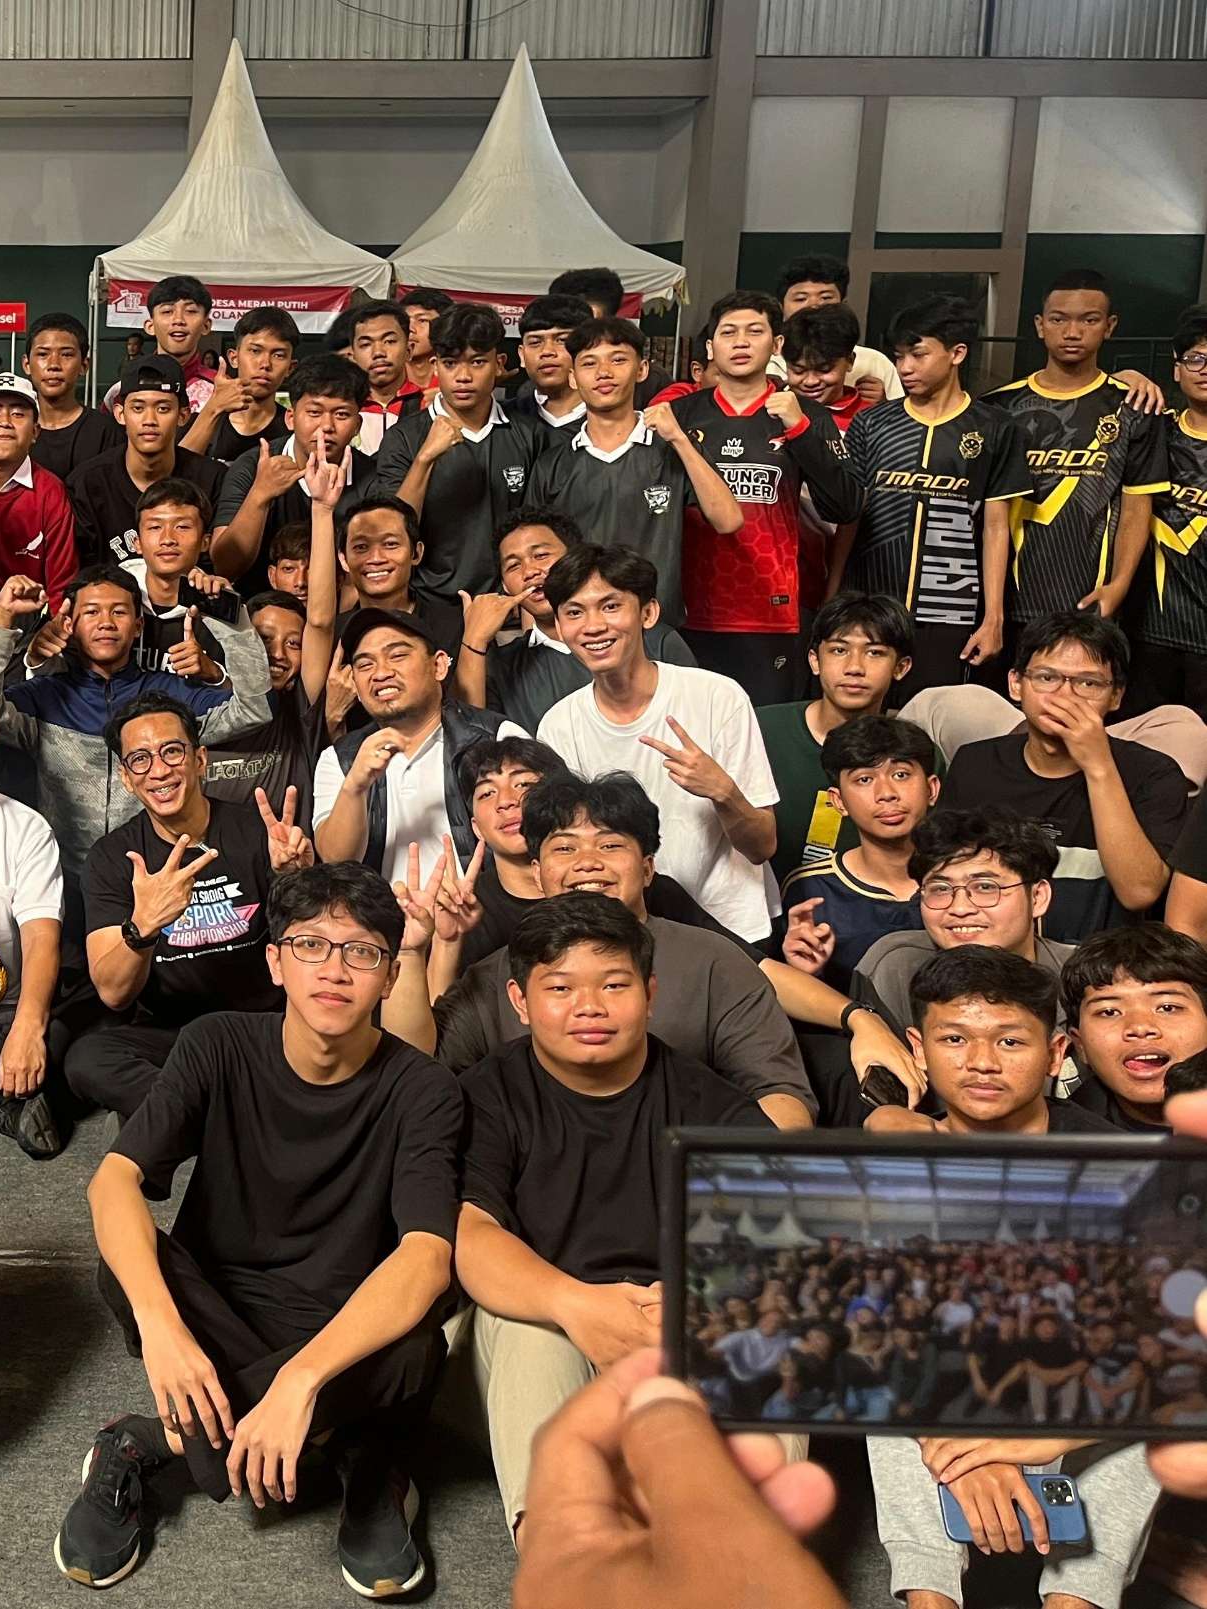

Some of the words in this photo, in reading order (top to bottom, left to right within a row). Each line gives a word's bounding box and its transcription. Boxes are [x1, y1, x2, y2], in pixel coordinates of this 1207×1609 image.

[238, 300, 275, 308] MERAH
[277, 301, 308, 309] PUTIH
[168, 920, 250, 946] CHAMPIONSHIP
